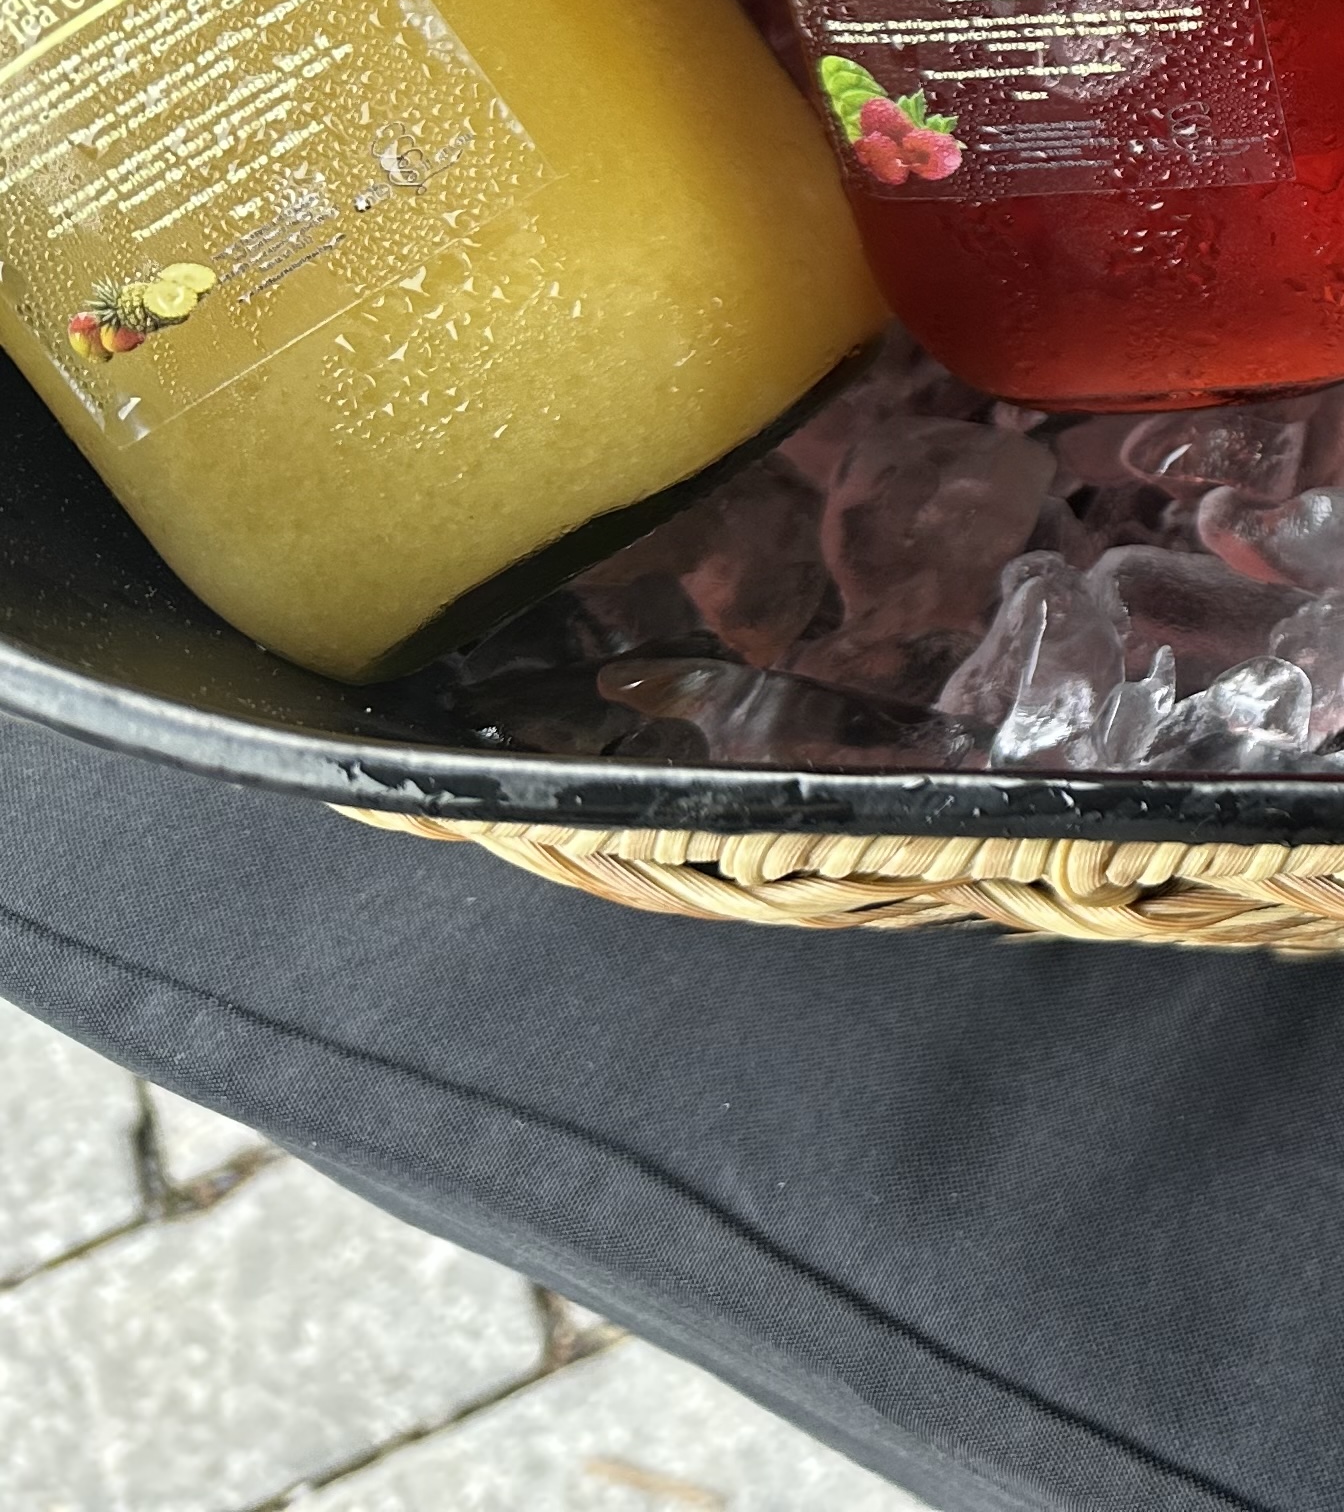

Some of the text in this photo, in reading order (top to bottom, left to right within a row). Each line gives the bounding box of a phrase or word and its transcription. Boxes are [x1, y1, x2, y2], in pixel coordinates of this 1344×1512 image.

[887, 18, 970, 31] Refrigerate
[923, 67, 1024, 80] Temperature:
[1026, 65, 1069, 76] Serve
[1014, 90, 1049, 101] 16oz
[270, 121, 324, 157] chilled.
